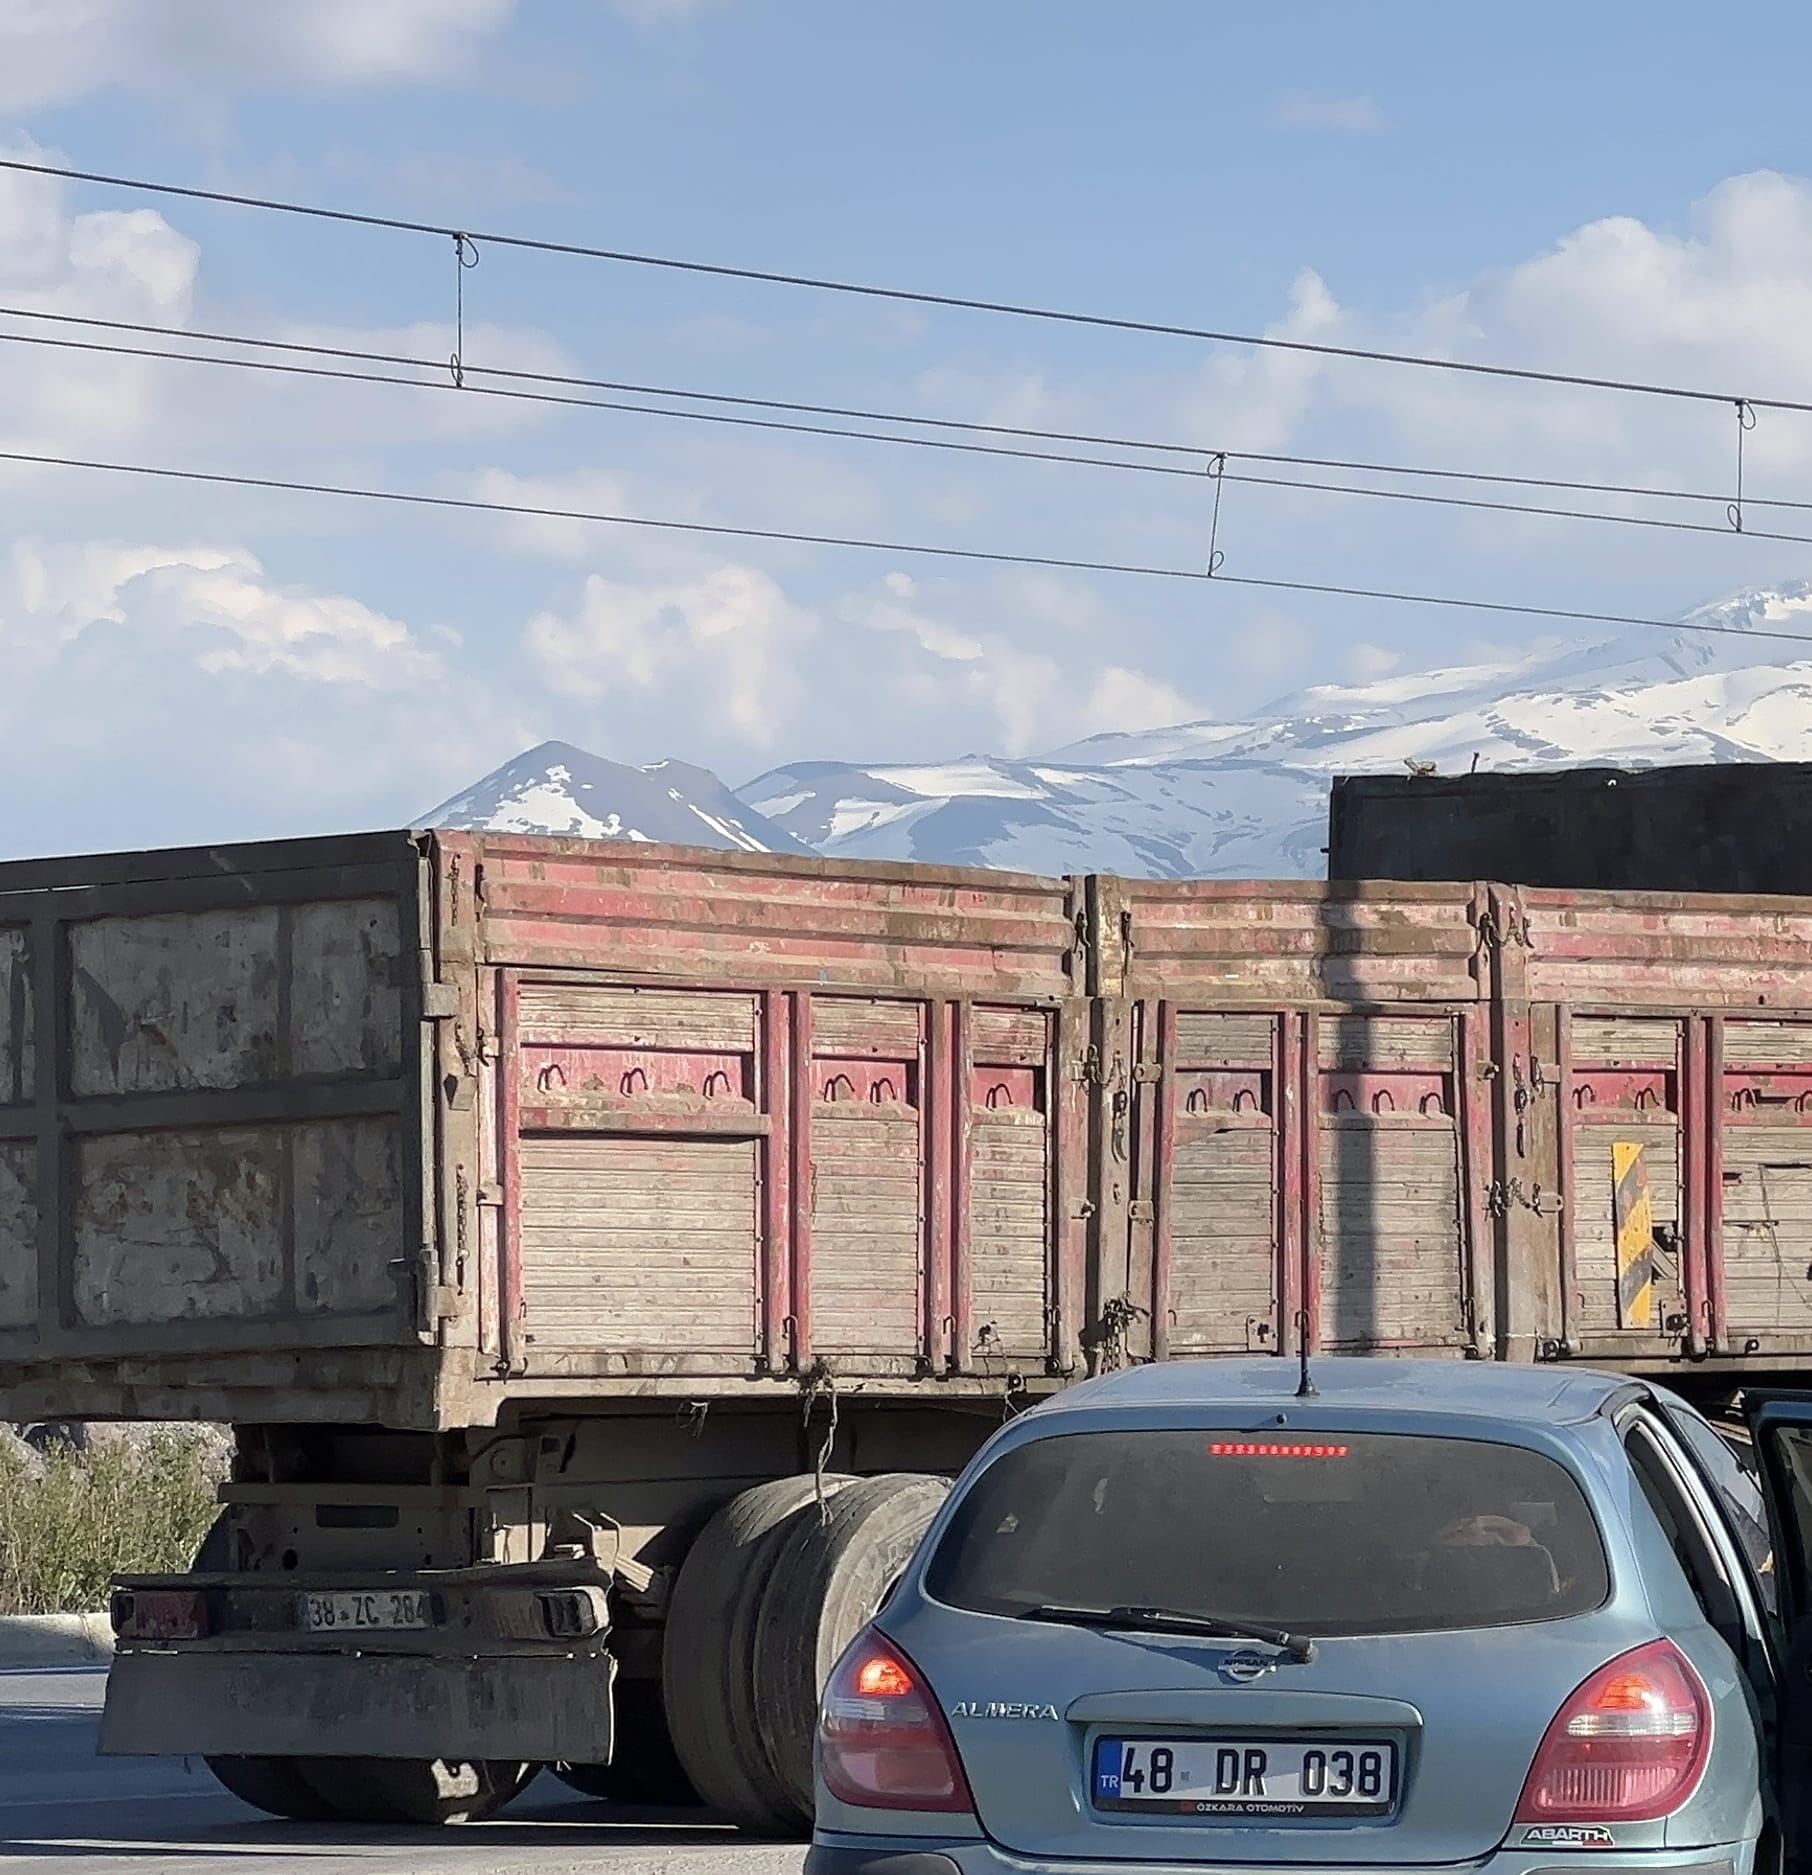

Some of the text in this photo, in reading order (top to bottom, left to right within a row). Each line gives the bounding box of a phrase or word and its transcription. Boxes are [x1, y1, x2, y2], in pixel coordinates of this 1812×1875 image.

[310, 1597, 335, 1626] 38
[352, 1596, 380, 1625] ZC
[951, 1700, 1060, 1722] ALMERA
[1101, 1747, 1382, 1797] TR 48 DR 038
[1527, 1827, 1608, 1841] ABARTH
